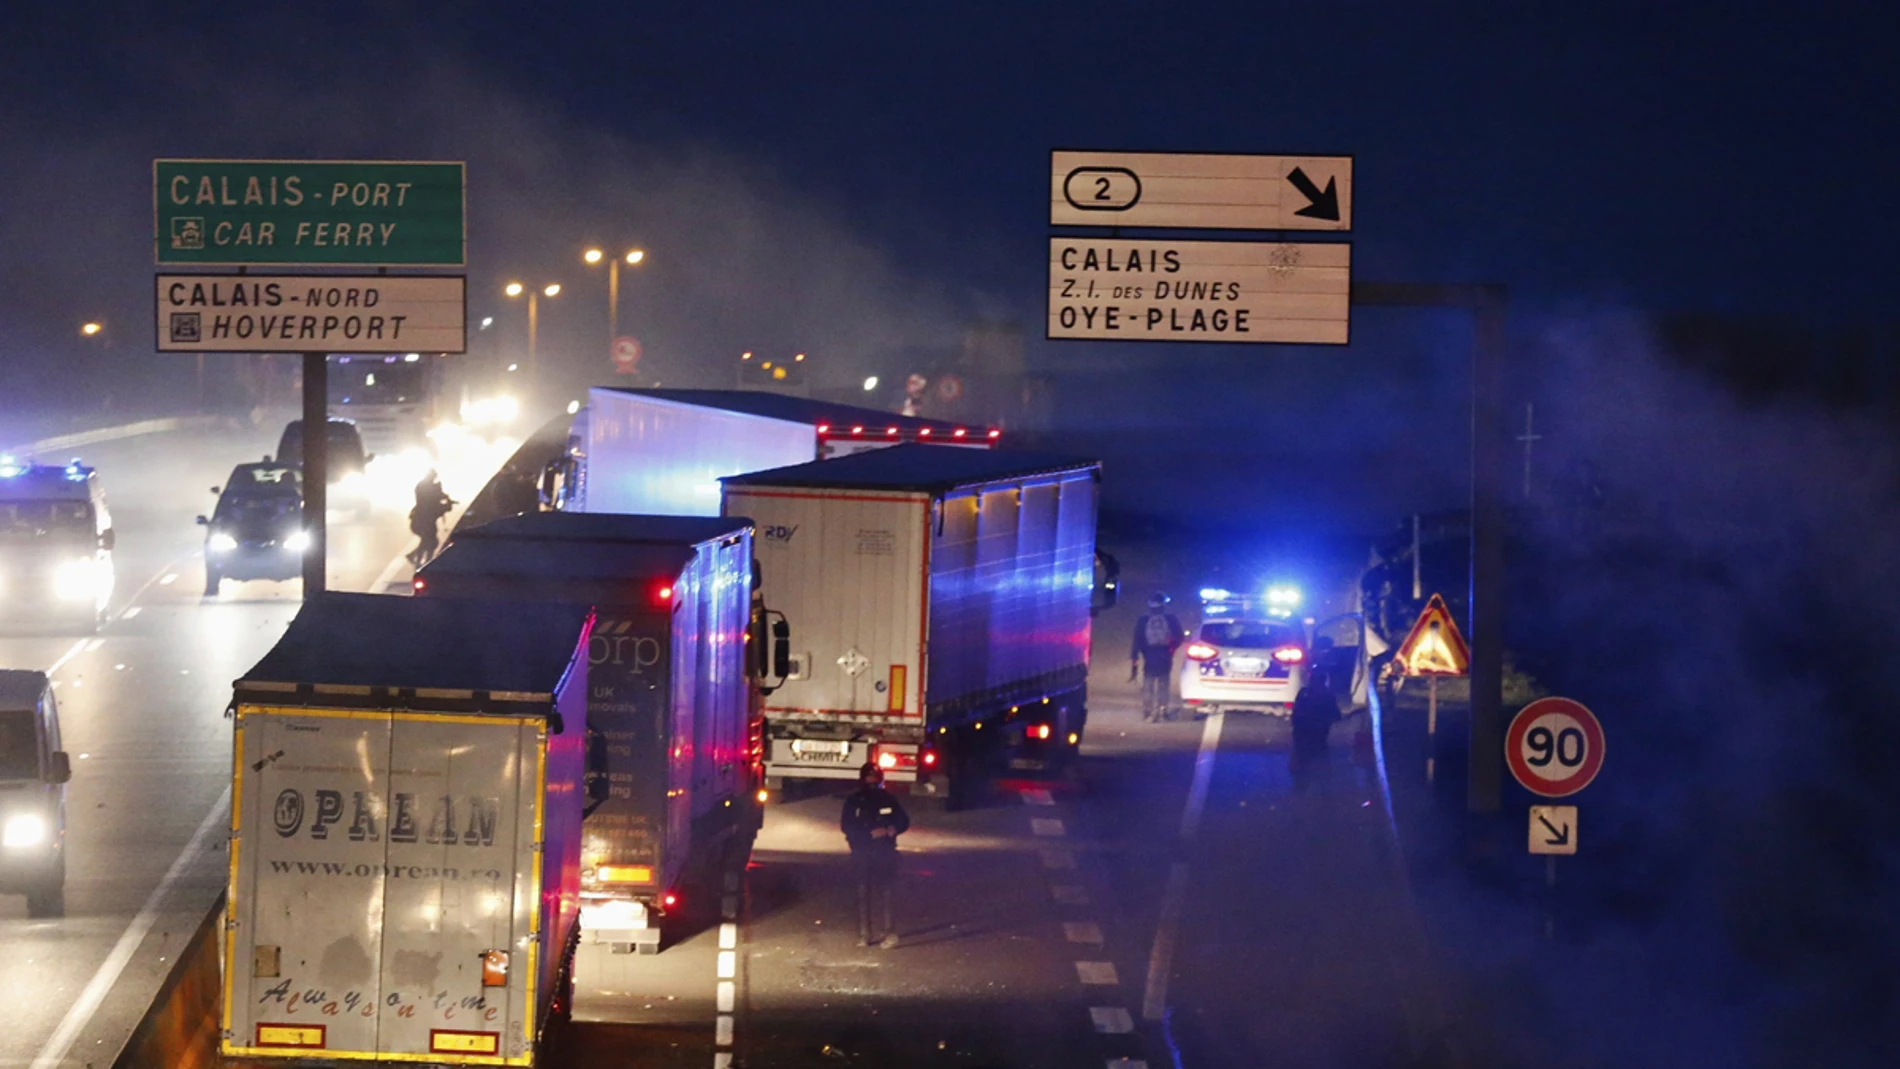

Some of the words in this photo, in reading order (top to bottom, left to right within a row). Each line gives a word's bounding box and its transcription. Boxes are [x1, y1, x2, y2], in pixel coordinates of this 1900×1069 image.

[1095, 178, 1111, 200] 2
[214, 222, 275, 246] CAR
[295, 222, 396, 246] FERRY
[1061, 248, 1181, 272] CALAIS
[1113, 286, 1143, 299] DES
[1155, 281, 1241, 301] DUNES
[212, 315, 406, 339] HOVERPORT
[593, 686, 615, 698] UK
[1527, 726, 1585, 767] 90
[273, 788, 498, 847] OPREAN
[258, 978, 379, 1019] Always
